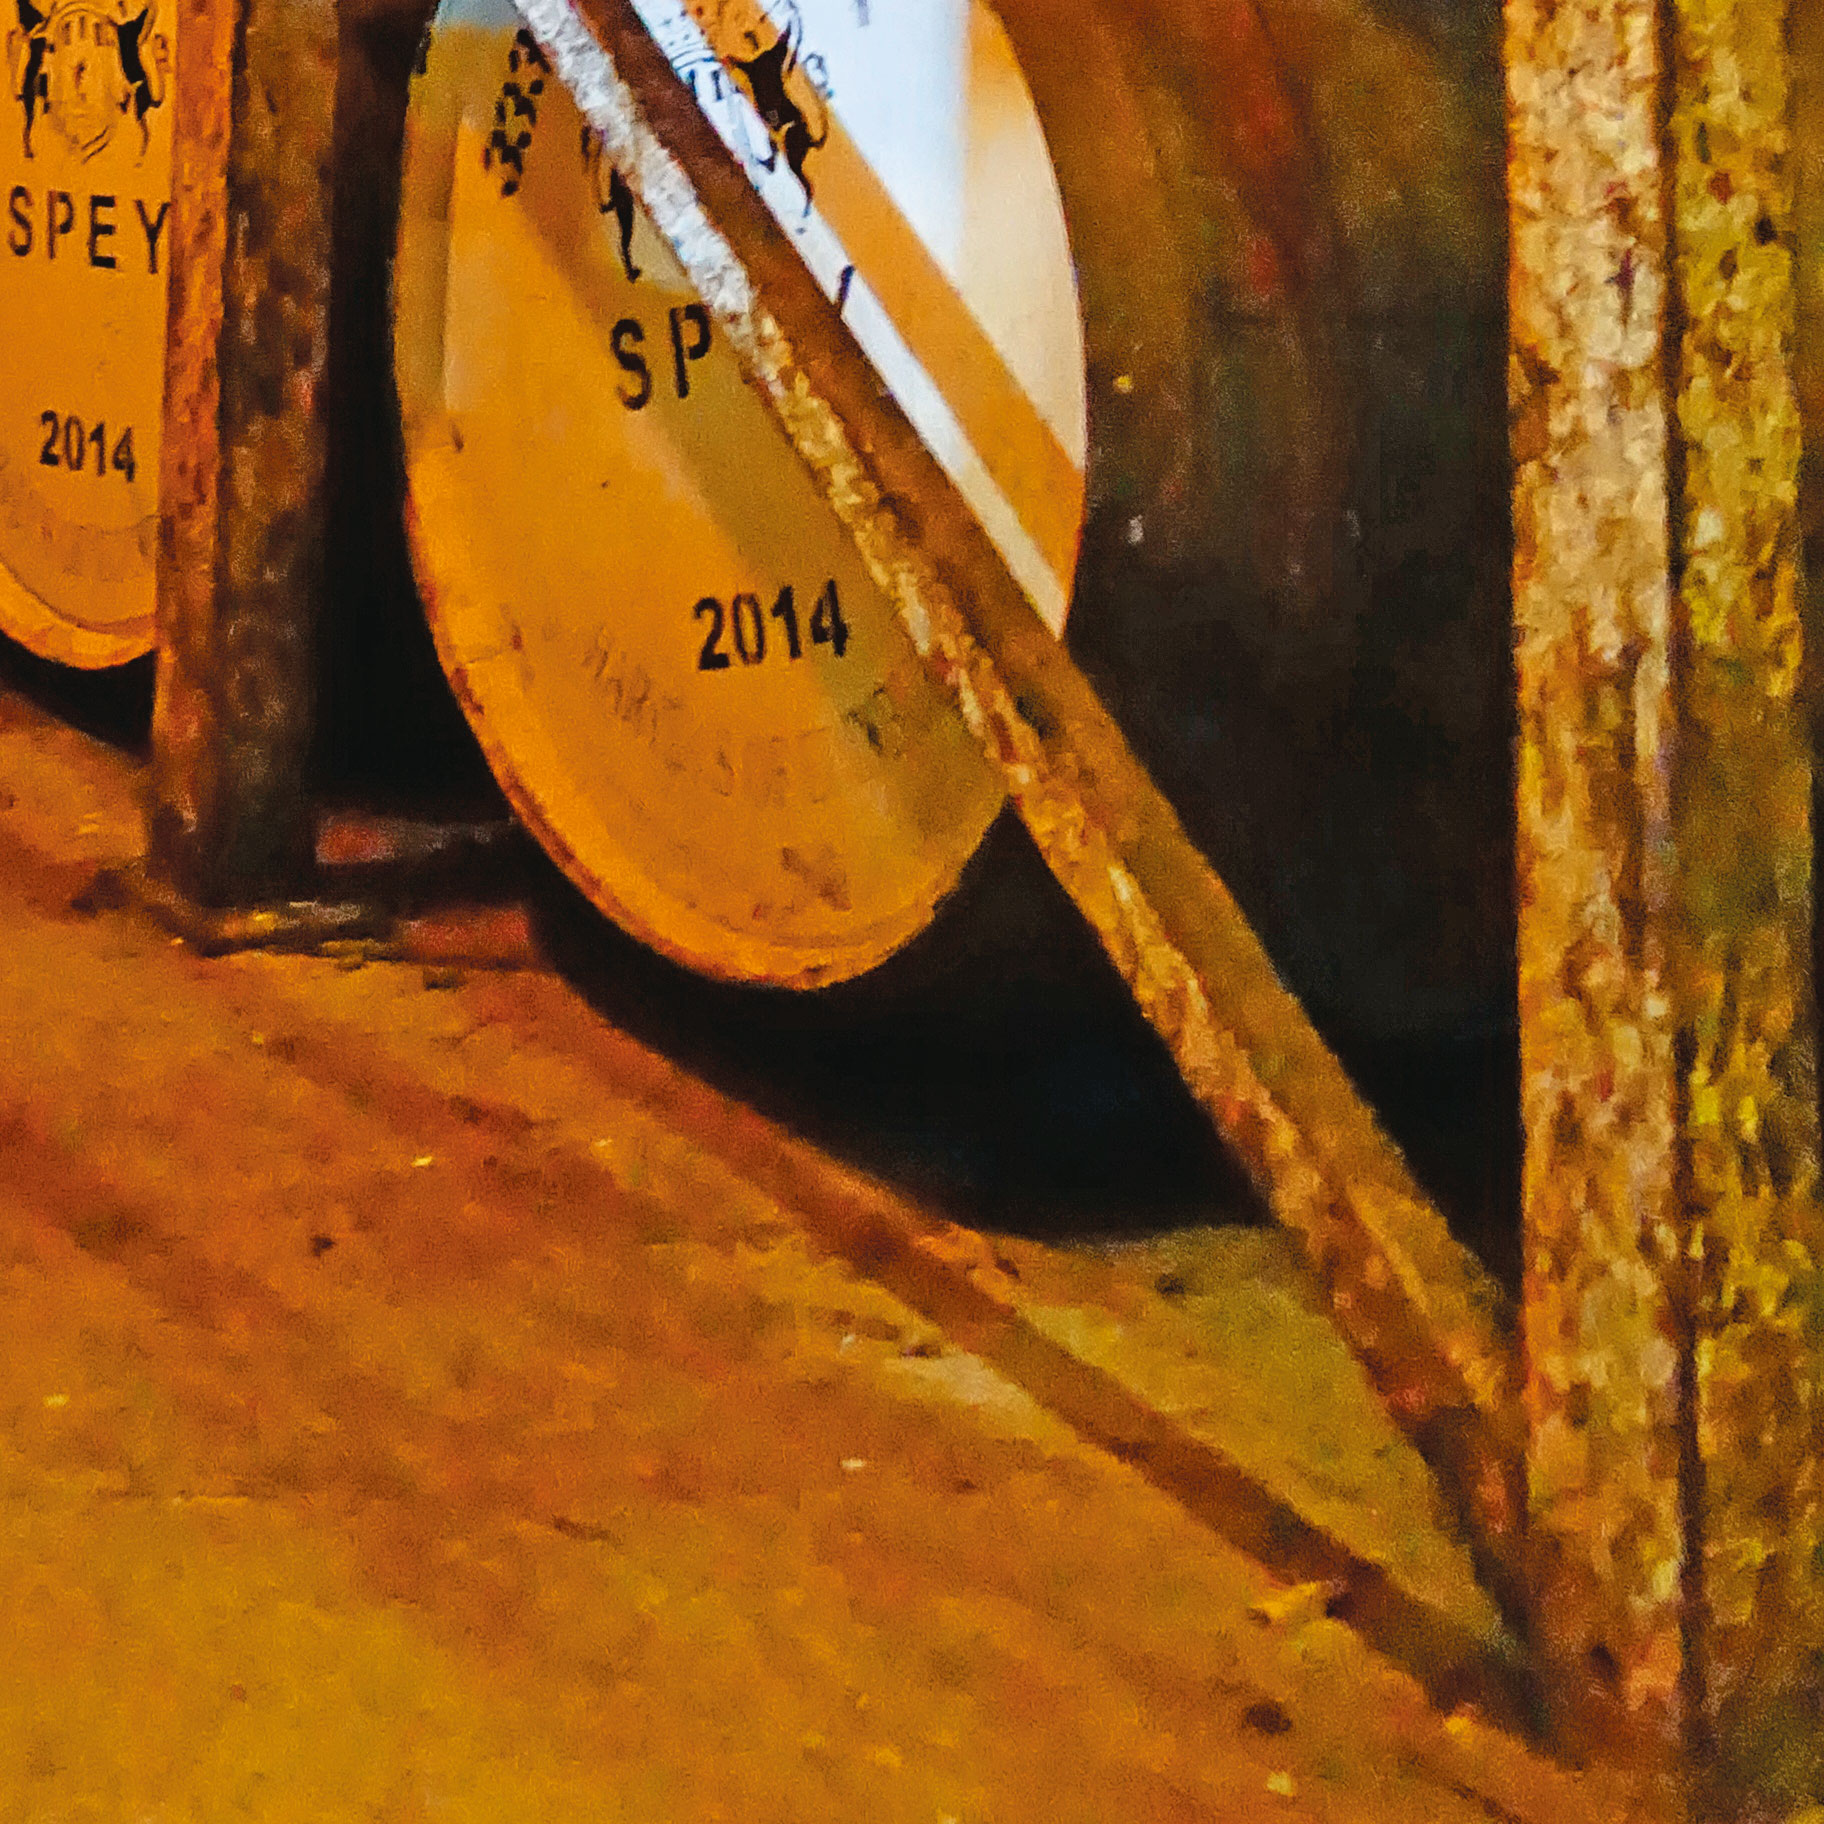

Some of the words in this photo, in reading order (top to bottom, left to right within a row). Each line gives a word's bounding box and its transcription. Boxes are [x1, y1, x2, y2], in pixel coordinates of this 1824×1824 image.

[9, 185, 173, 275] SPEY
[39, 409, 135, 483] 2014
[692, 577, 850, 672] 2014
